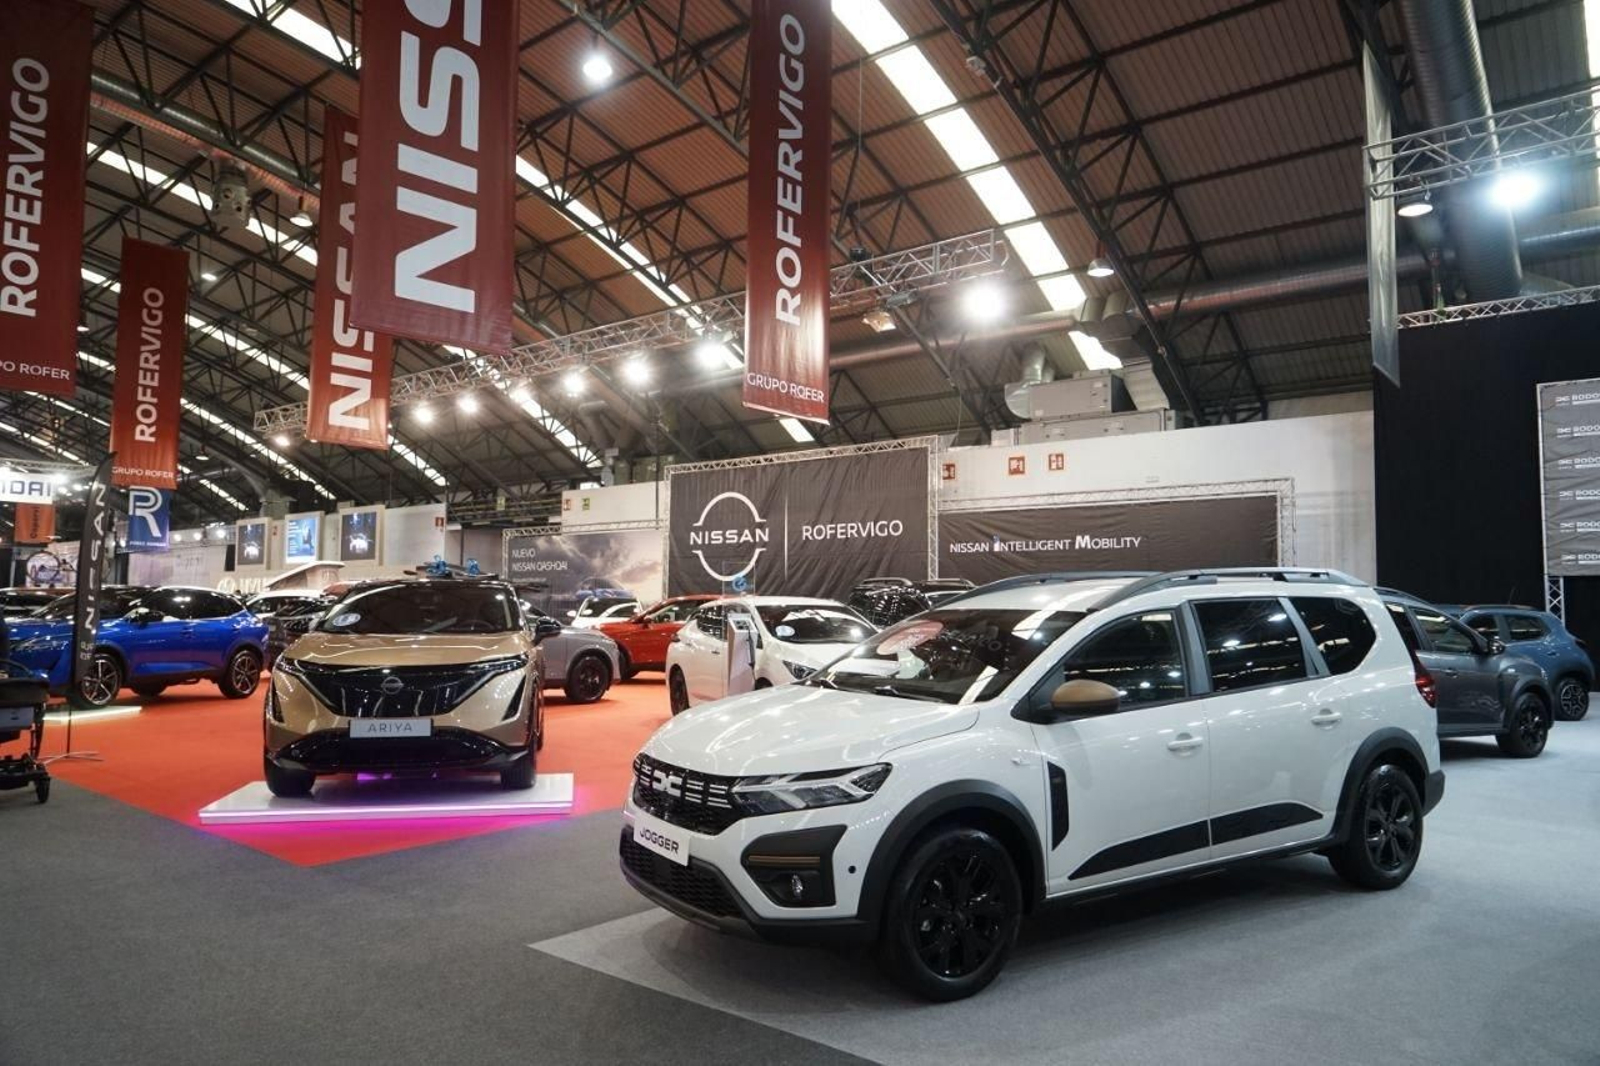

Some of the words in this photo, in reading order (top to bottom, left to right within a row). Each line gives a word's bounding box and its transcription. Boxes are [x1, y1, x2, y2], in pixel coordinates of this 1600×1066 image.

[775, 13, 806, 326] ROFERVIGO
[1, 57, 50, 318] ROFERVIGO
[20, 363, 70, 380] ROFER
[134, 286, 165, 444] ROFERVIGO
[747, 372, 788, 394] GRUPO
[790, 382, 825, 404] ROFER
[112, 466, 143, 476] GRUPO
[145, 468, 174, 479] ROFER
[690, 528, 769, 545] NISSAN
[802, 519, 903, 541] ROFERVIGO
[512, 548, 535, 558] NUEVO
[950, 542, 989, 553] NISSAN
[367, 722, 412, 733] ARIYA
[640, 827, 680, 854] JOGGER
